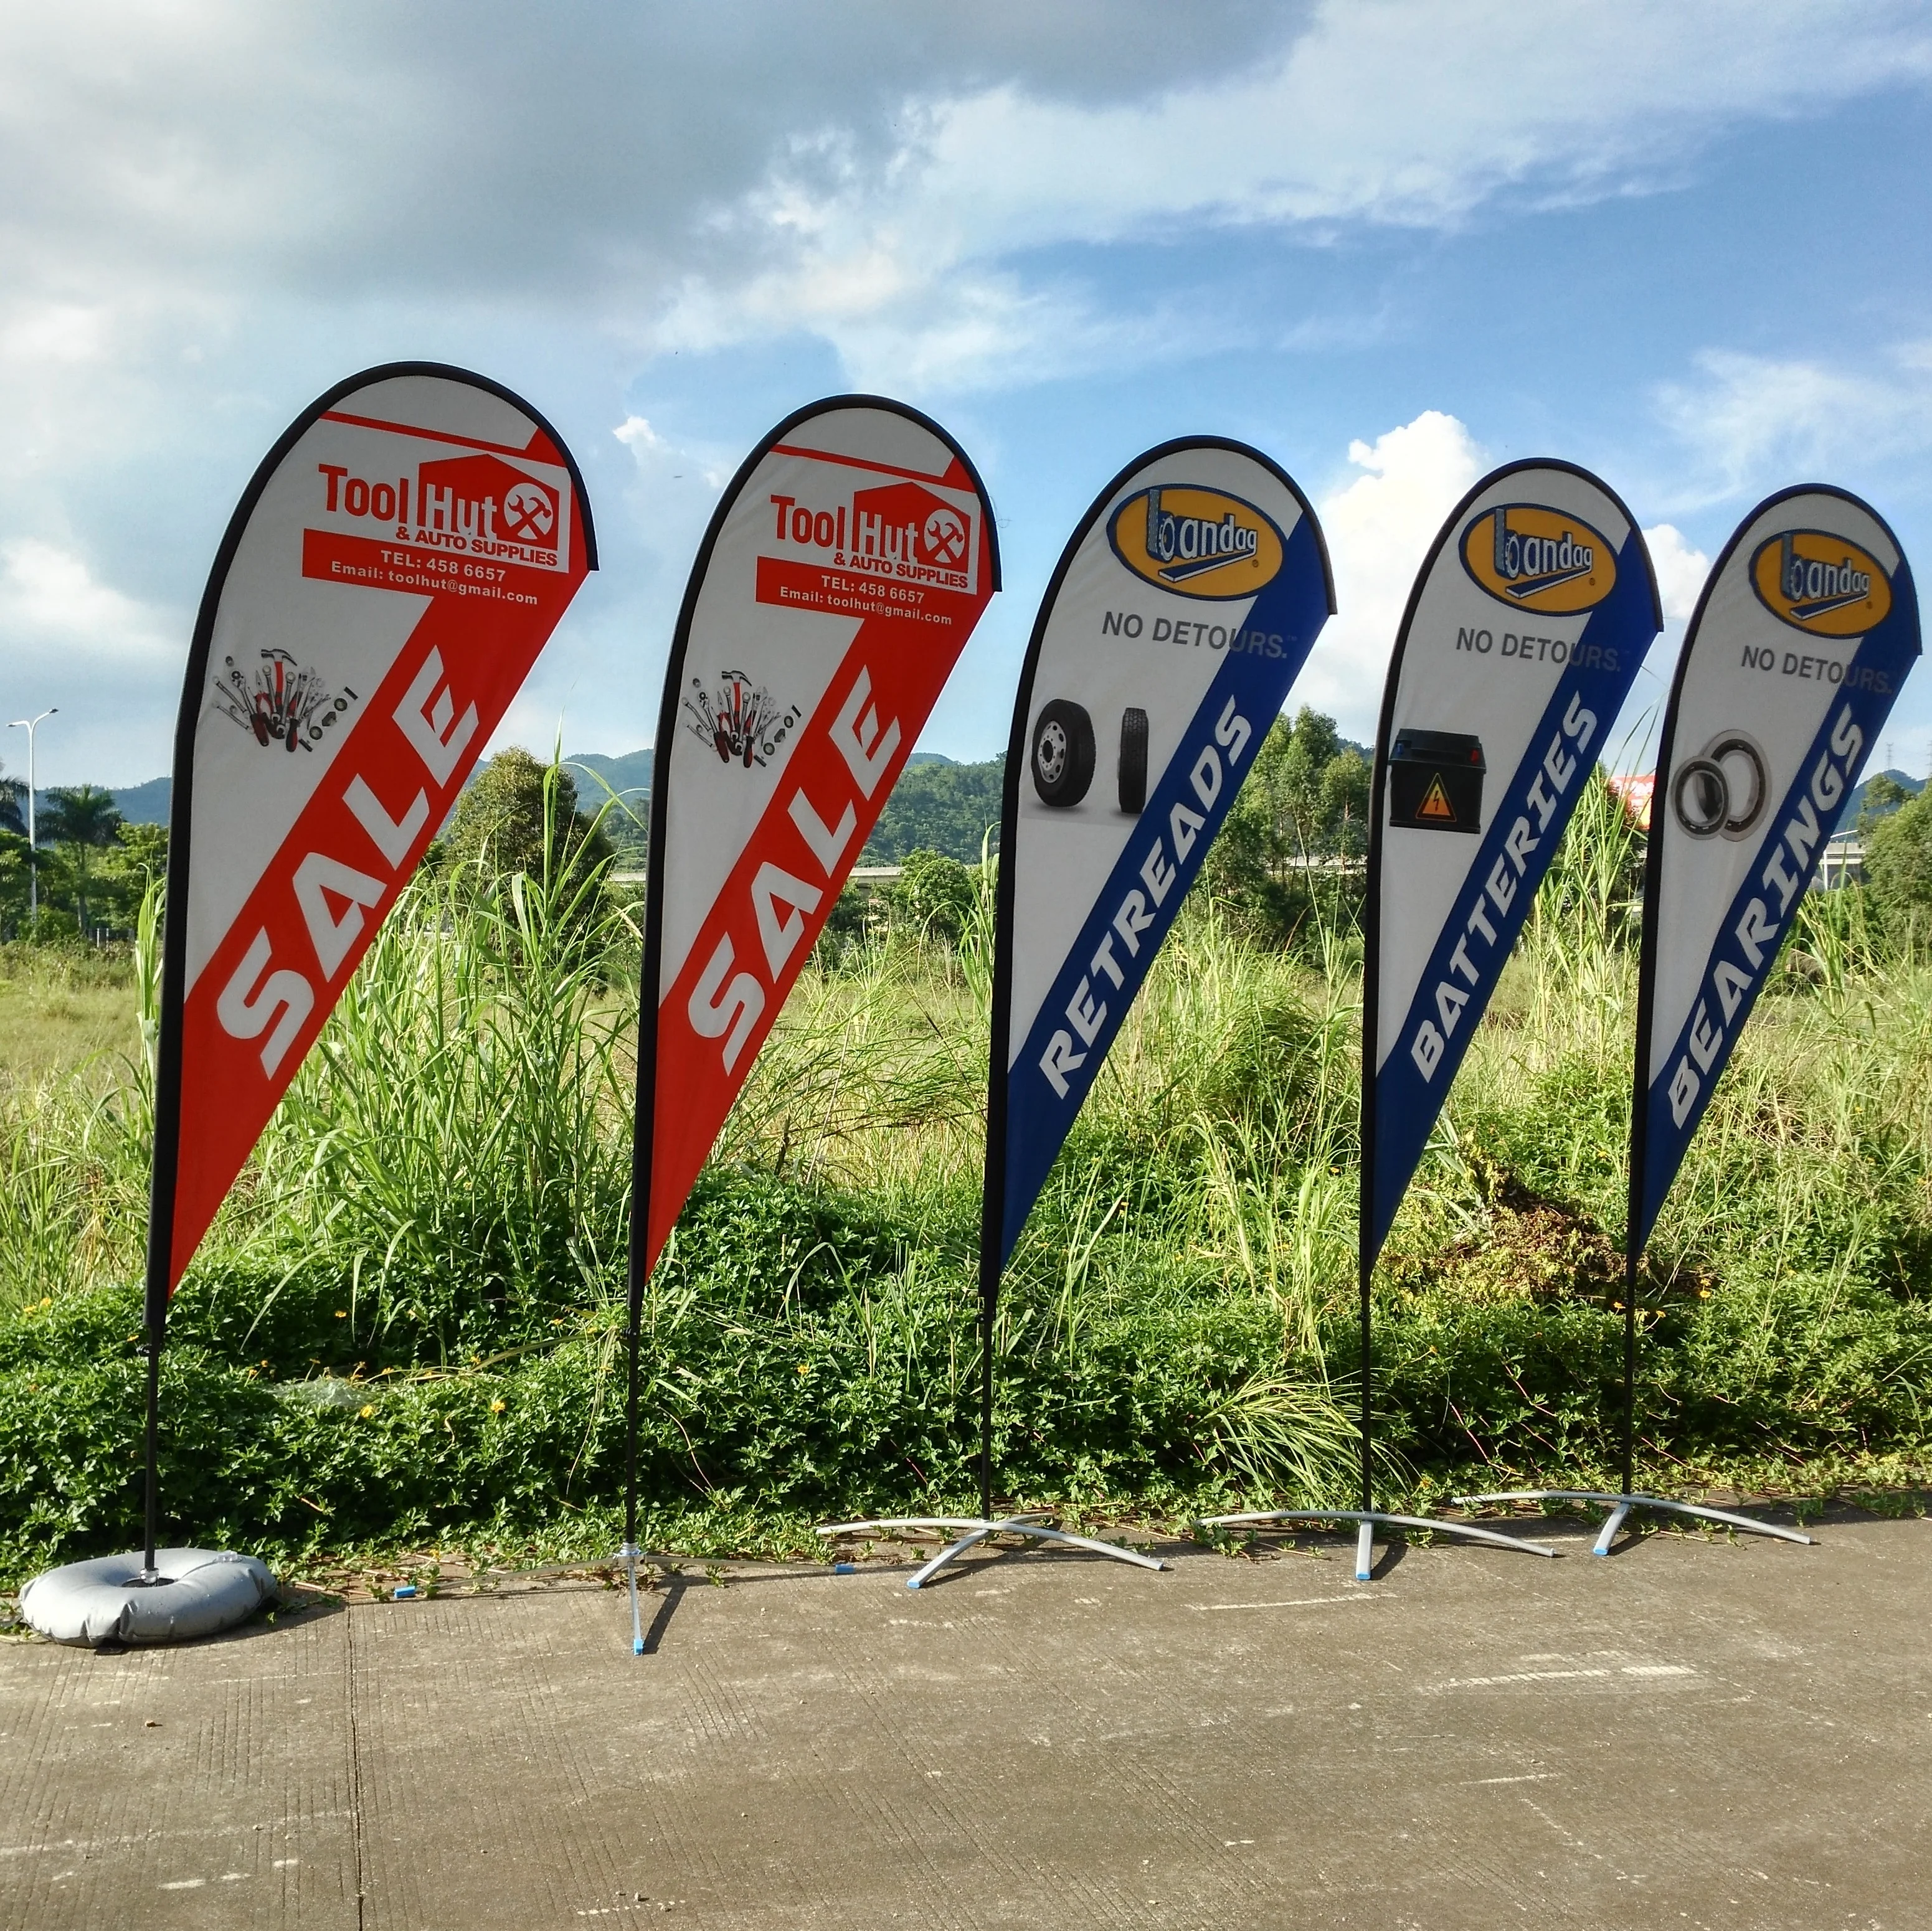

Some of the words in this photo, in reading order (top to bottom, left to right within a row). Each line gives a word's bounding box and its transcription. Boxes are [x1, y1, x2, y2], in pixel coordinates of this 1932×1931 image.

[318, 463, 409, 524] Tool
[425, 483, 498, 540] Hut
[770, 494, 846, 549] Tool
[859, 511, 918, 564] Hut
[1146, 489, 1257, 563] bandag
[381, 550, 421, 569] TEL:
[427, 557, 458, 575] 458
[463, 563, 506, 582] 6657
[395, 526, 410, 541] &
[415, 529, 467, 550] AUTO
[471, 539, 558, 567] SUPPLIES
[834, 552, 846, 565] &
[850, 555, 893, 574] AUTO
[896, 564, 968, 588] SUPPLIES
[1494, 508, 1593, 580] bandag
[1781, 533, 1870, 602] bandag
[331, 560, 384, 580] Email:
[389, 569, 537, 605] toolhut@gmail.com
[780, 586, 823, 603] Email:
[827, 594, 952, 625] toolhut@gmail.com
[822, 575, 855, 592] TEL:
[859, 582, 885, 598] 458
[889, 587, 924, 603] 6657
[1102, 611, 1144, 639] NO
[1152, 617, 1288, 659] DETOURS.
[1456, 627, 1493, 653] NO
[1501, 633, 1621, 672] DETOURS.
[1741, 645, 1774, 671] NO
[217, 644, 479, 1080] SALE
[688, 664, 901, 1077] SALE
[1411, 690, 1598, 1083] BATTERIES
[1039, 694, 1251, 1100] RETREADS
[1668, 703, 1863, 1130] BEARINGS
